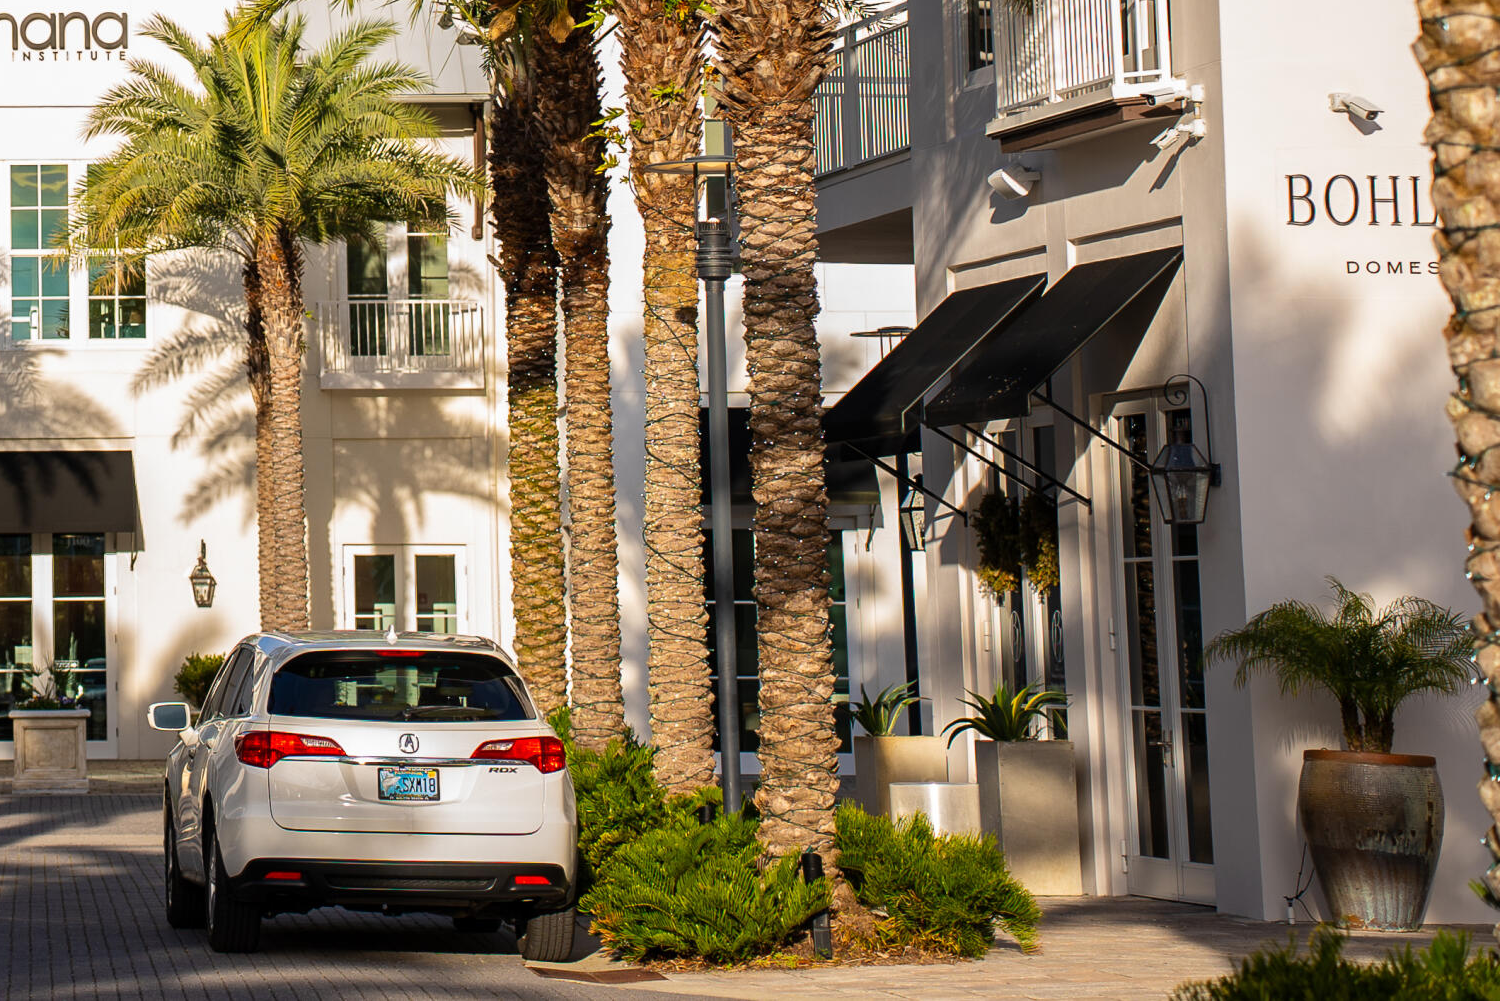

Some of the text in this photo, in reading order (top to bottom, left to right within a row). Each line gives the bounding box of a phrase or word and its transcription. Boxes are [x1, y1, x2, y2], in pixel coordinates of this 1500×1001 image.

[12, 51, 126, 62] INSTITUTE
[1284, 174, 1439, 227] BOHL
[1346, 261, 1440, 275] DOMES
[401, 777, 436, 793] SXM18
